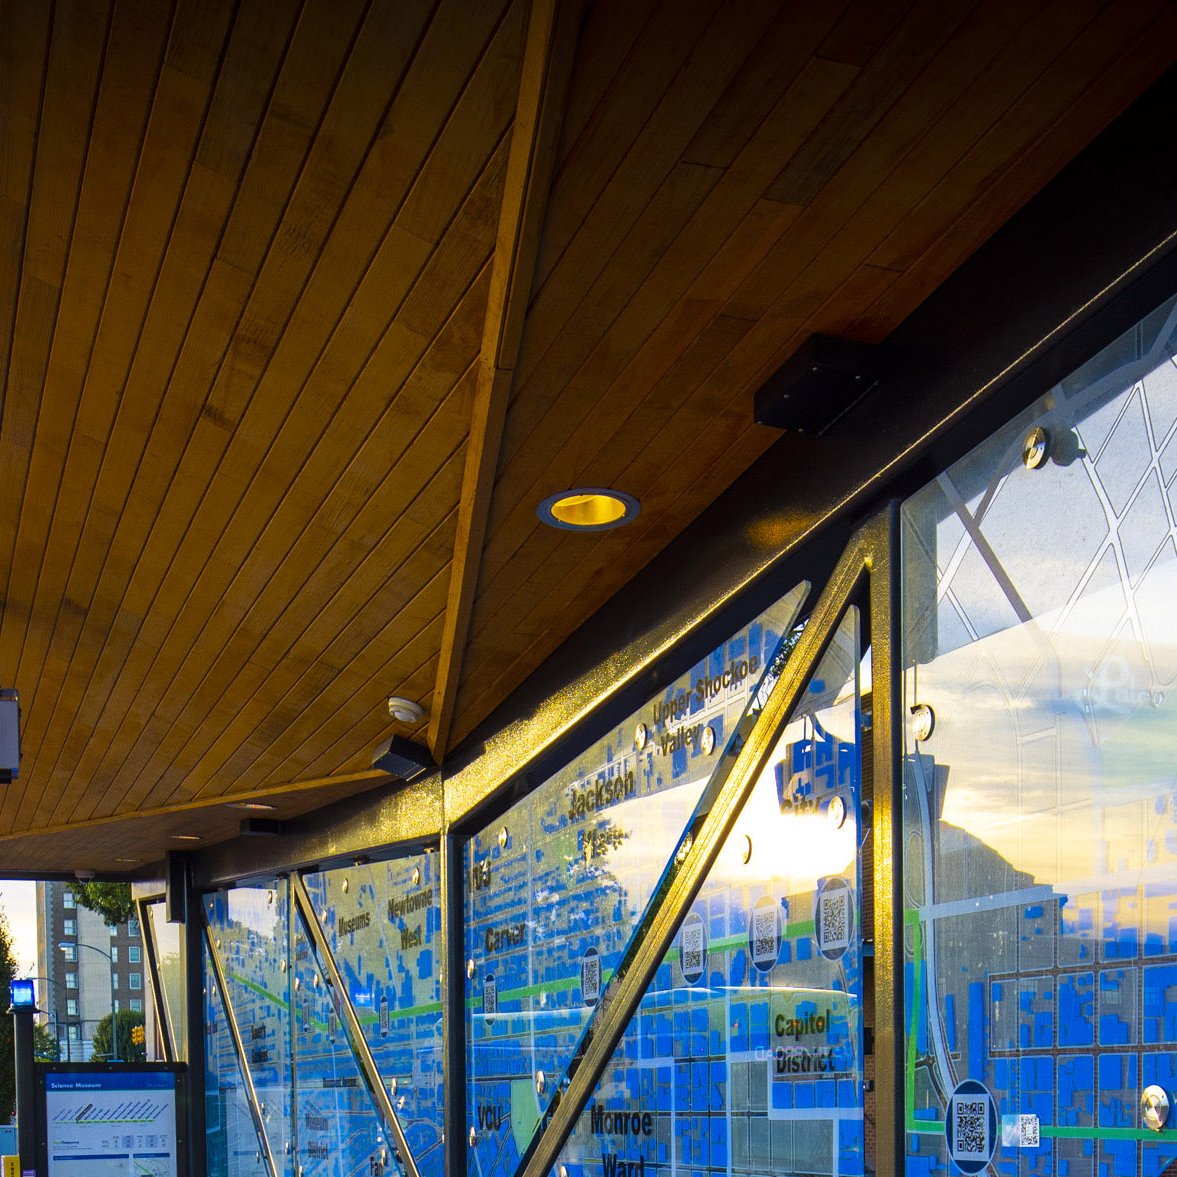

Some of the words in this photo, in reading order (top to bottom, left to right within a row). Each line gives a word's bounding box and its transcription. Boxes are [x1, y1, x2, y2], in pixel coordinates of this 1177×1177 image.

[653, 690, 691, 726] Upper
[696, 657, 759, 699] Shockoe
[661, 722, 702, 756] Valley
[568, 770, 634, 820] Jackson
[388, 888, 432, 921] Newtowne
[338, 912, 370, 938] Museums
[401, 924, 422, 950] West
[485, 924, 525, 953] Carver
[775, 1009, 831, 1041] Capitol
[777, 1047, 836, 1073] District
[478, 1105, 501, 1131] VCU
[591, 1105, 652, 1136] Monroe
[370, 1156, 383, 1177] Fan
